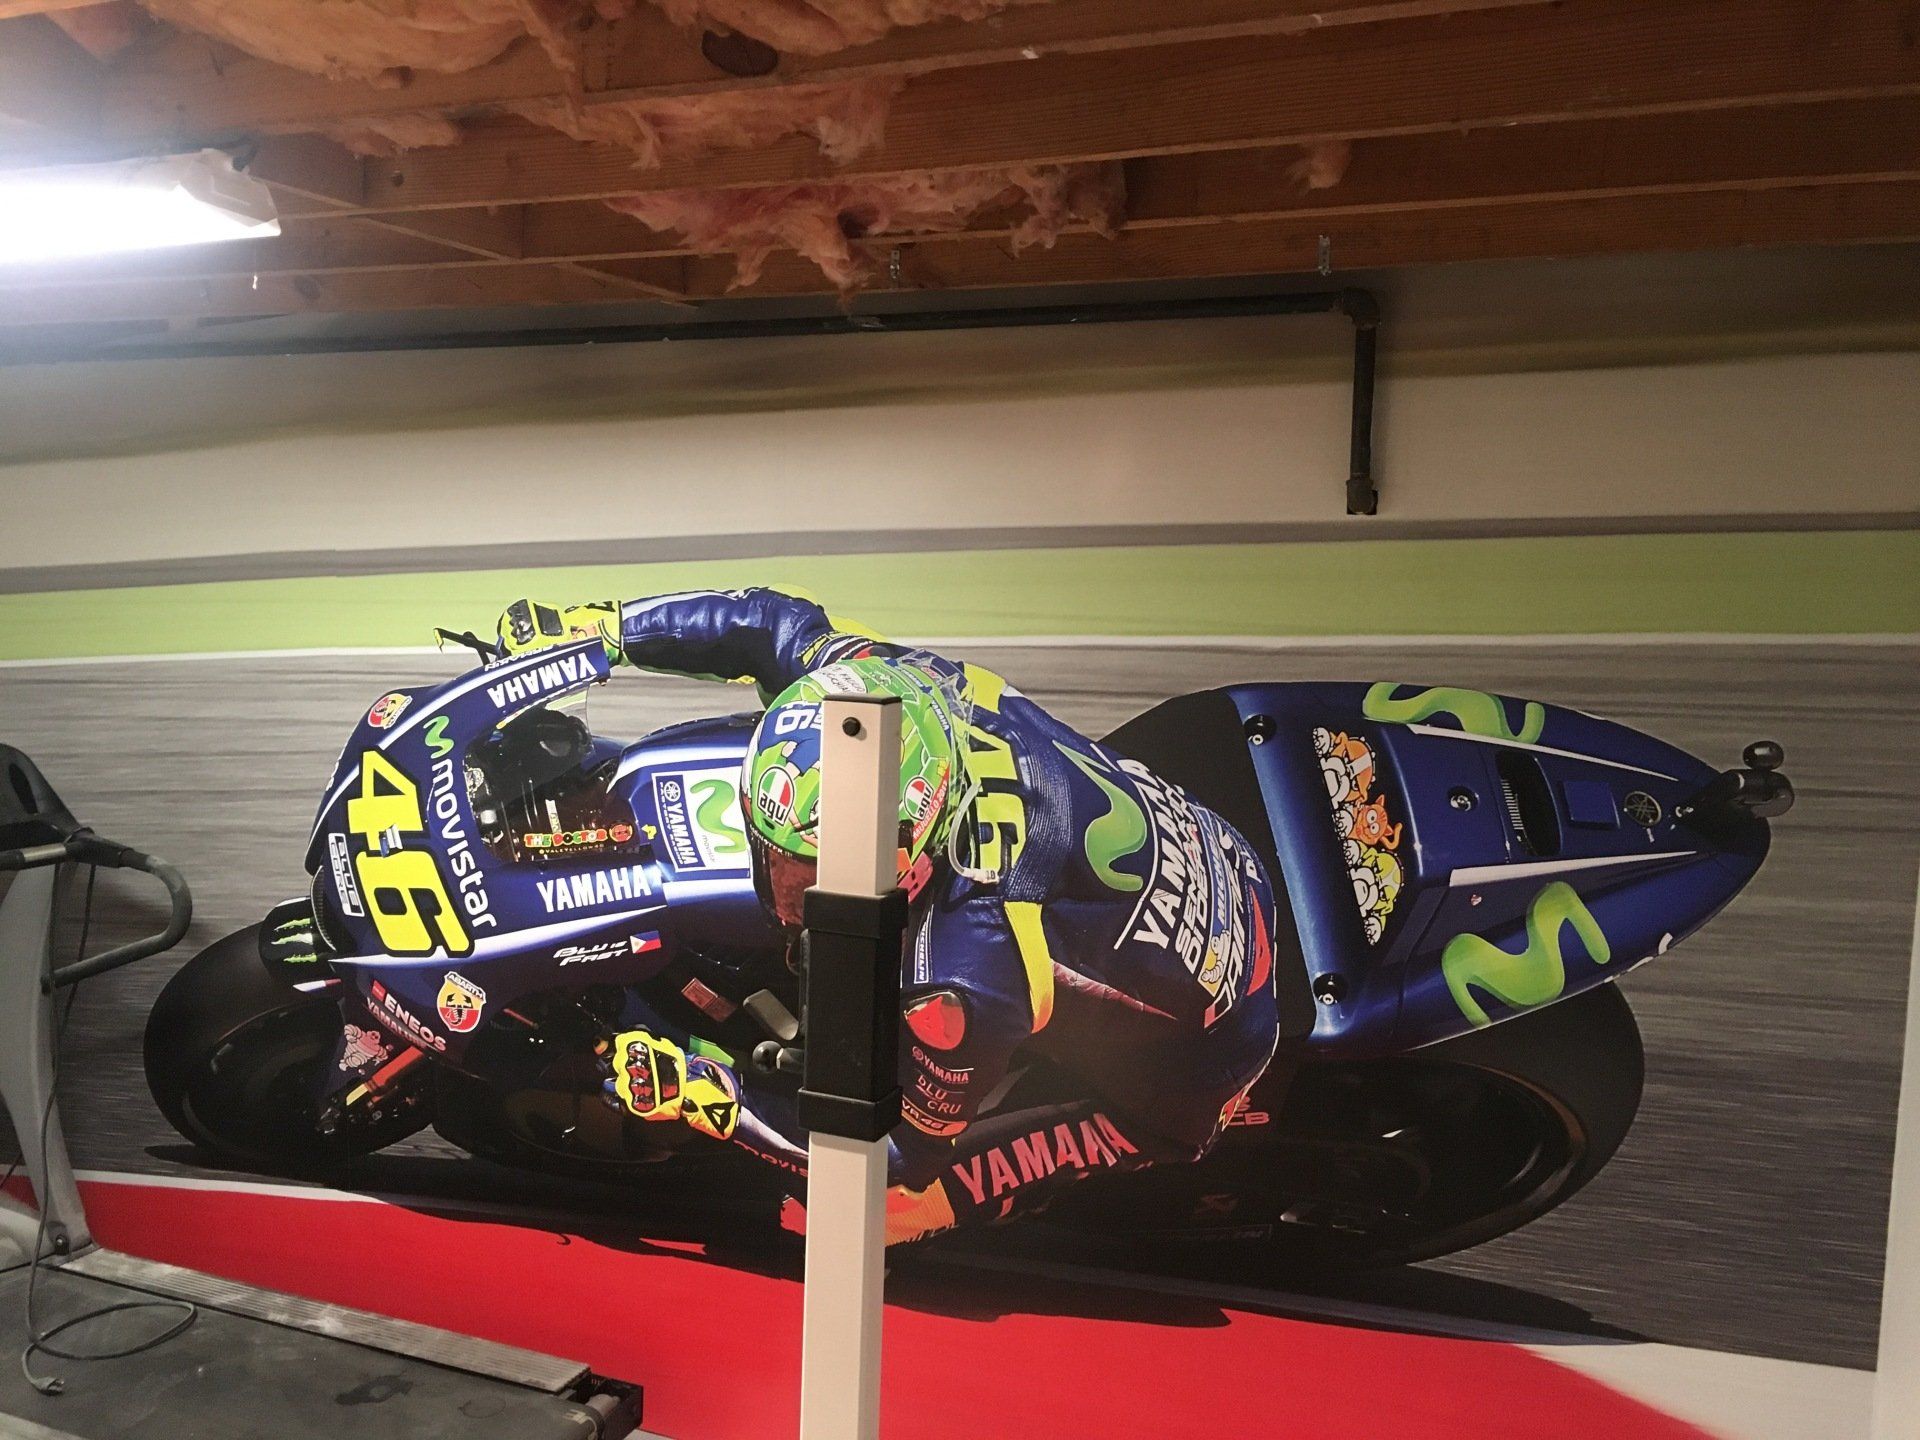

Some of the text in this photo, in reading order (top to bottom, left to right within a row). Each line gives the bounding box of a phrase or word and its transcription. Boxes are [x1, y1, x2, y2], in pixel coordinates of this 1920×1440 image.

[486, 652, 598, 708] YAMAHA
[348, 750, 471, 953] 46
[431, 758, 497, 928] movistar
[524, 828, 608, 847] THE DOCTOR
[667, 802, 698, 865] YAMAHA
[337, 840, 358, 907] BLUE
[536, 864, 651, 913] YAMAHA
[384, 992, 447, 1052] ENEOS
[924, 1055, 969, 1083] YAMAHA
[952, 1112, 1139, 1205] YAMAHA
